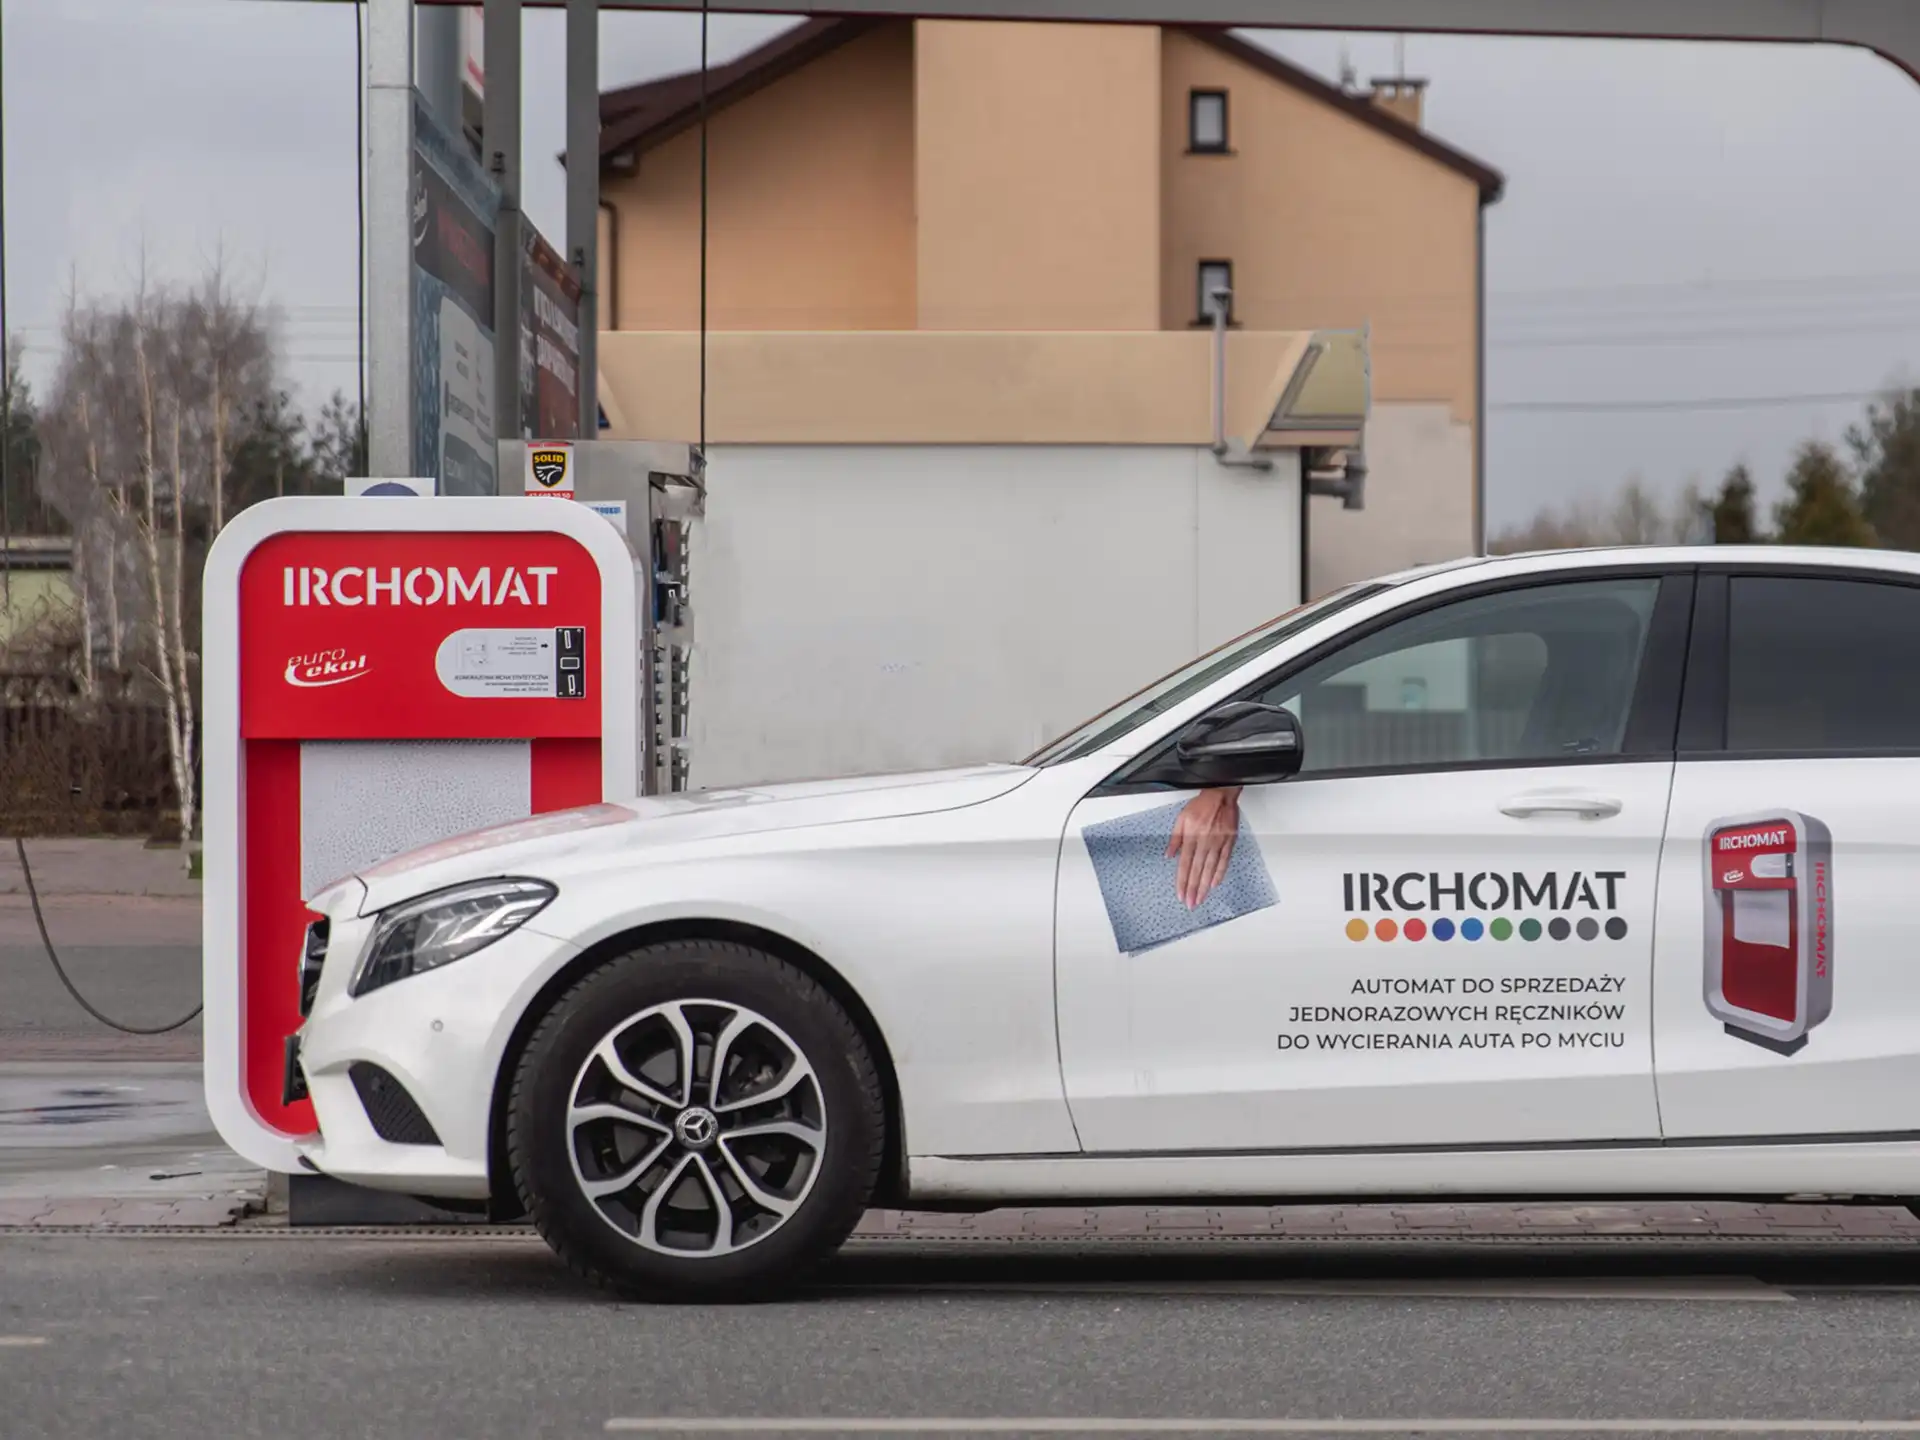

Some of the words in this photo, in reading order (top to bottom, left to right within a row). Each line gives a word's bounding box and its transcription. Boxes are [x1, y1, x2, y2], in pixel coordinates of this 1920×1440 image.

[534, 454, 564, 463] SOLID
[283, 566, 558, 606] IRCHOMAT
[288, 647, 346, 668] euro
[306, 654, 366, 677] ekol
[1719, 830, 1788, 850] IRCHOMAT
[1343, 870, 1627, 912] IRCHOMAT
[1350, 978, 1456, 994] AUTOMAT
[1462, 978, 1495, 994] DO
[1500, 973, 1626, 994] SPRZEDAŻY
[1288, 1005, 1488, 1022] JEDNORAZOWYCH
[1495, 1001, 1626, 1025] RĘCZNIKÓW
[1277, 1034, 1310, 1050] DO
[1316, 1033, 1453, 1049] WYCIERANIA
[1458, 1033, 1515, 1049] AUTA
[1521, 1032, 1552, 1048] PO
[1558, 1032, 1625, 1048] MYCIU
